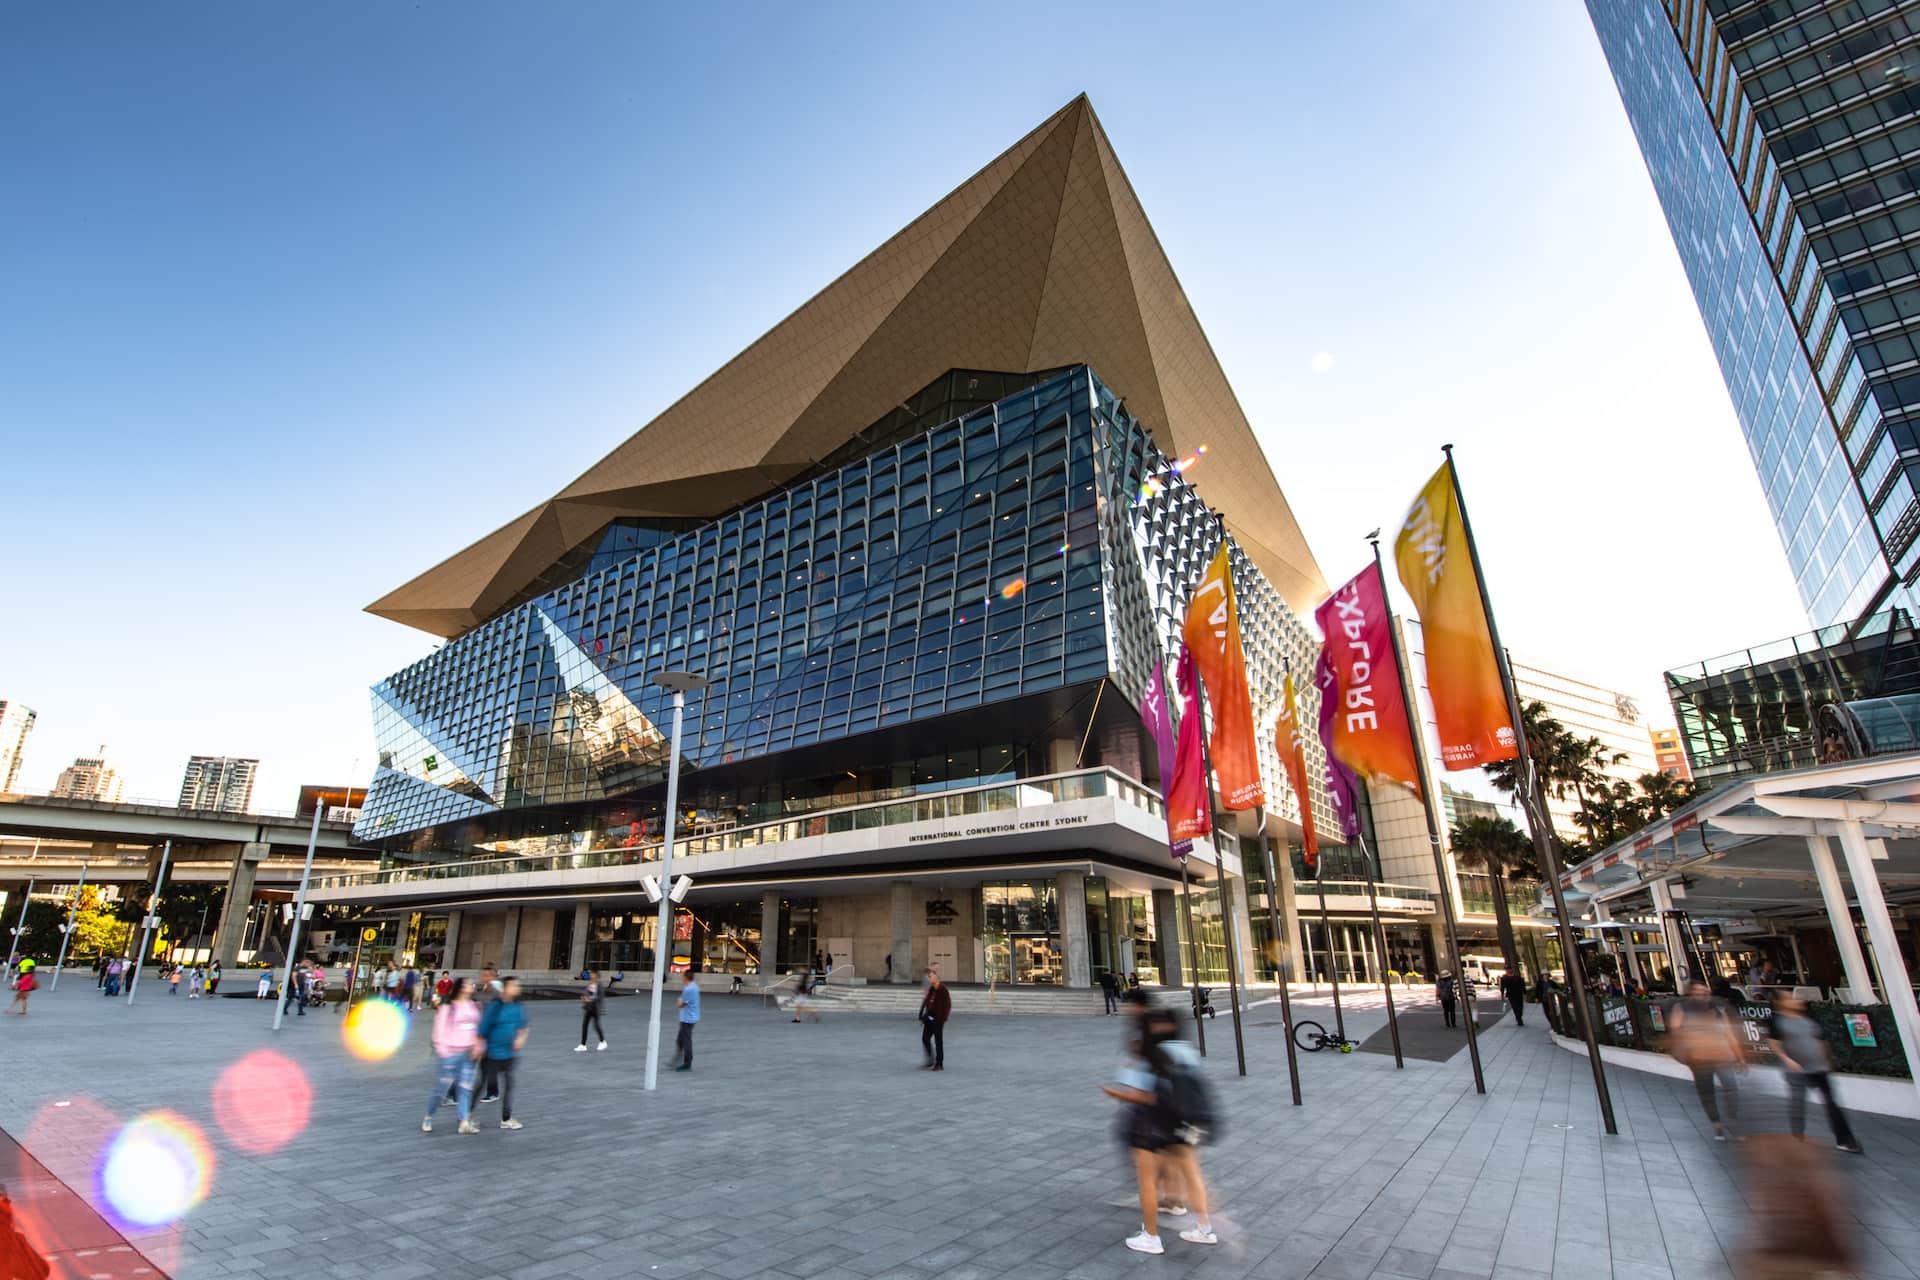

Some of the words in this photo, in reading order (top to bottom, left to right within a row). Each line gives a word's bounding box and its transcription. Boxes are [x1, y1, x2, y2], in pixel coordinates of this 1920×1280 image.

[909, 830, 961, 842] INTERNATIONAL
[966, 824, 1015, 836] CONVENTION
[1019, 819, 1050, 830] CENTRE
[1055, 815, 1088, 826] SYDNEY
[1739, 1007, 1772, 1018] HOUR
